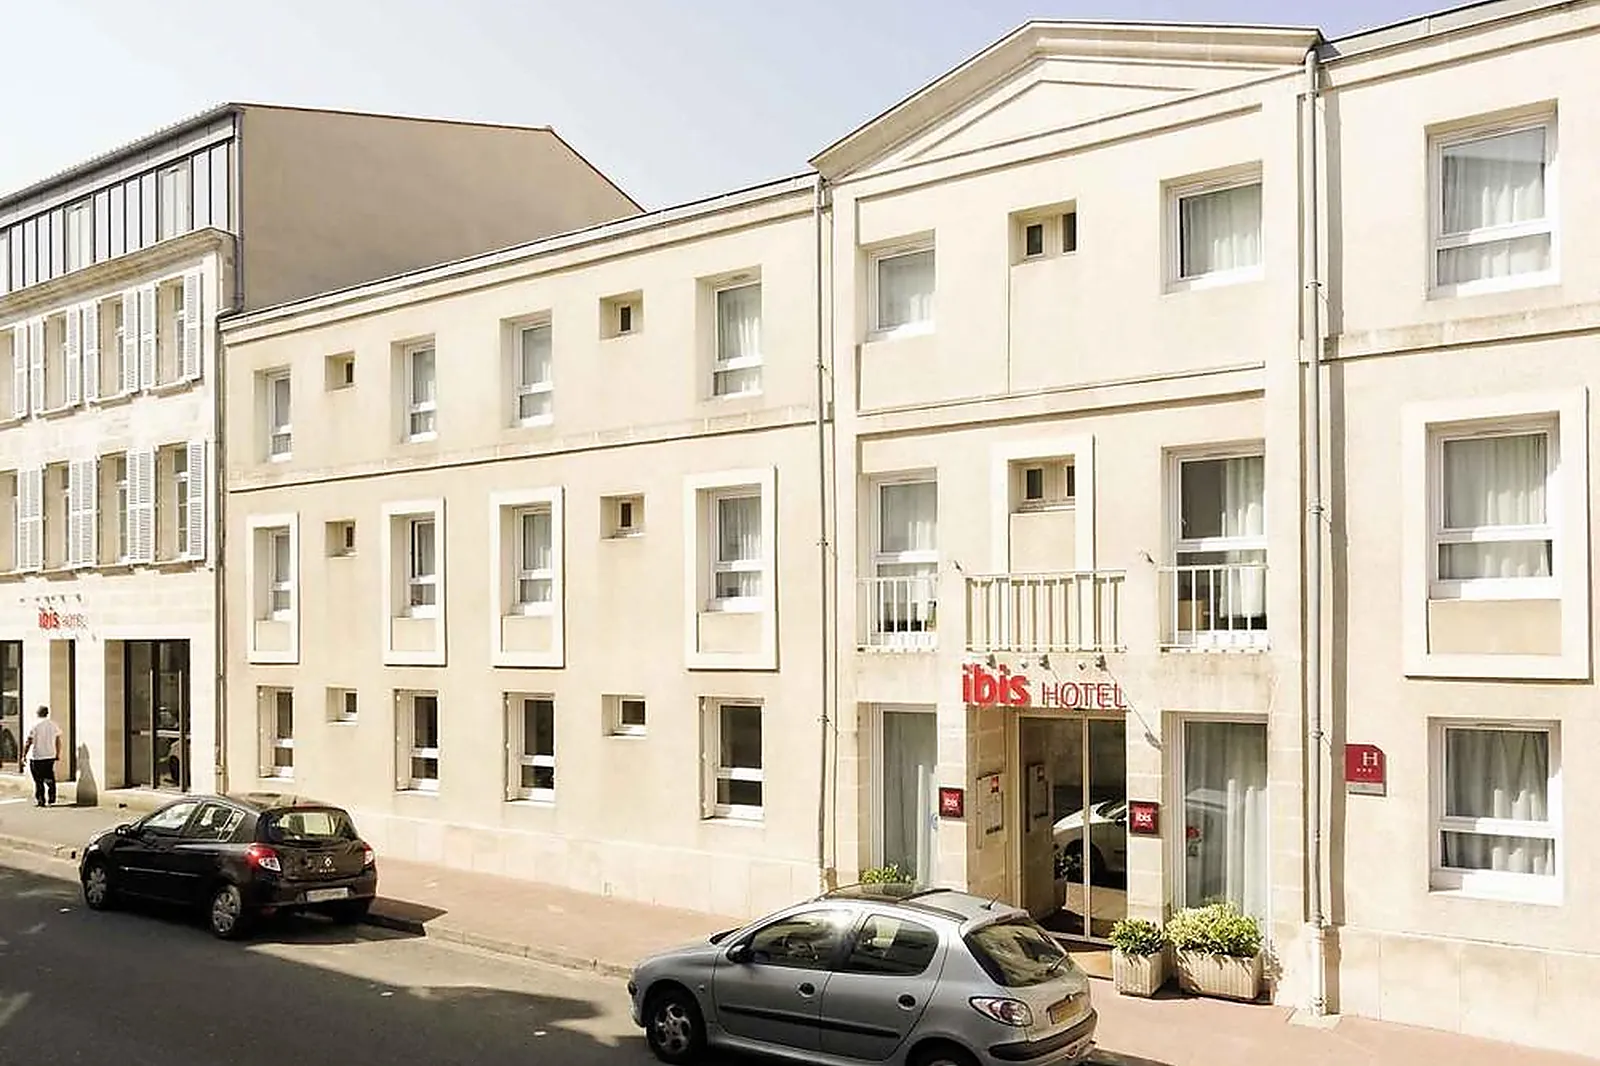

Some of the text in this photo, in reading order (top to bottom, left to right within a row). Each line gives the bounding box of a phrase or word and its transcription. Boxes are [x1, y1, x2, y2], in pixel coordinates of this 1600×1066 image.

[962, 663, 1128, 708] ibis HOTEL
[1362, 751, 1378, 766] H
